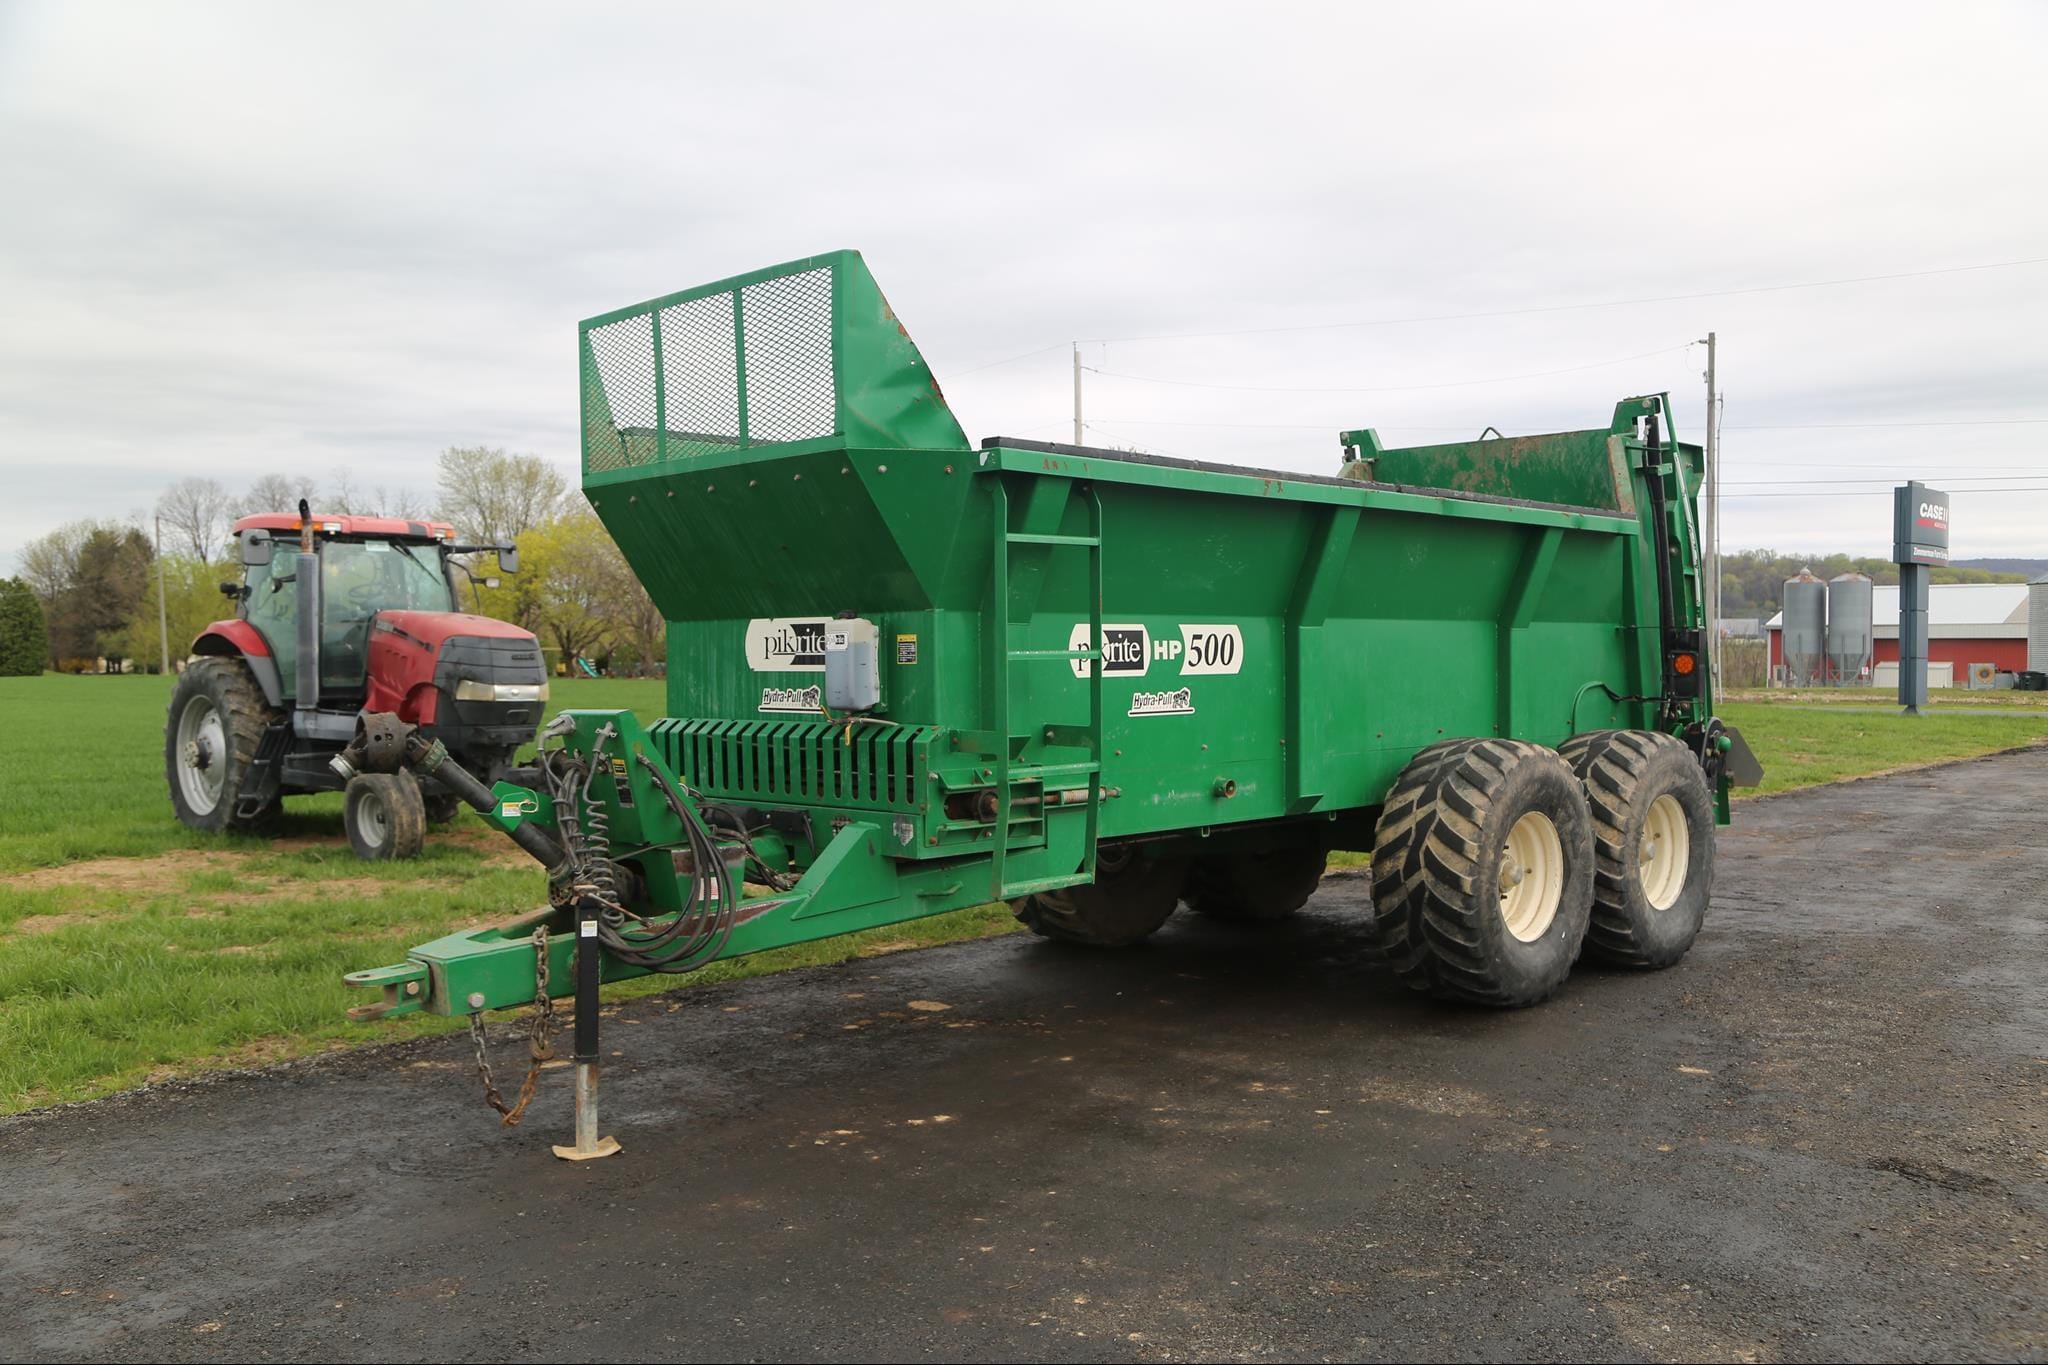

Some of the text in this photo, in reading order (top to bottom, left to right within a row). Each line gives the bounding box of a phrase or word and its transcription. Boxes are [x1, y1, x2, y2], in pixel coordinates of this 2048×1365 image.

[1920, 503, 1943, 520] CASE
[1154, 640, 1182, 660] HP
[1188, 633, 1235, 667] 500
